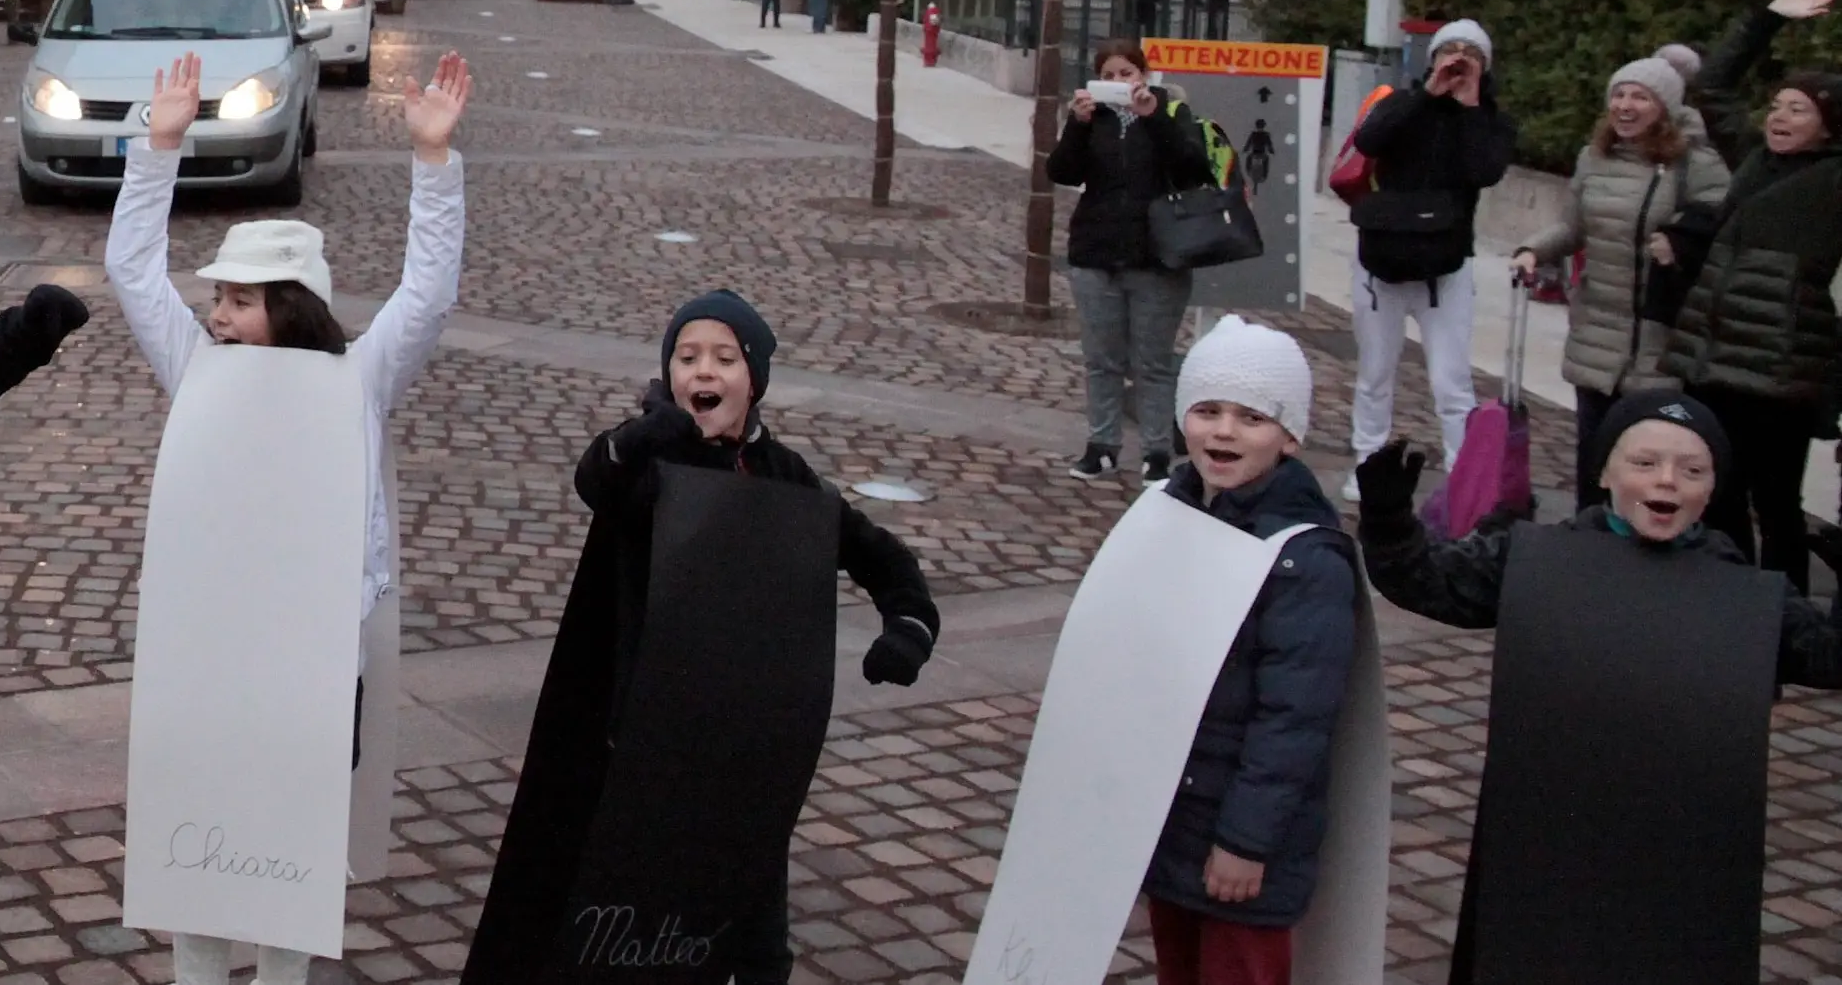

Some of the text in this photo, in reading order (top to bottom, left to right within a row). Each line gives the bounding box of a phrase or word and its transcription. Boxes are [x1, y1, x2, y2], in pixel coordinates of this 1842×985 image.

[1145, 44, 1321, 70] ATTENZIONE
[163, 821, 313, 883] Chiara
[574, 904, 732, 967] Matteo
